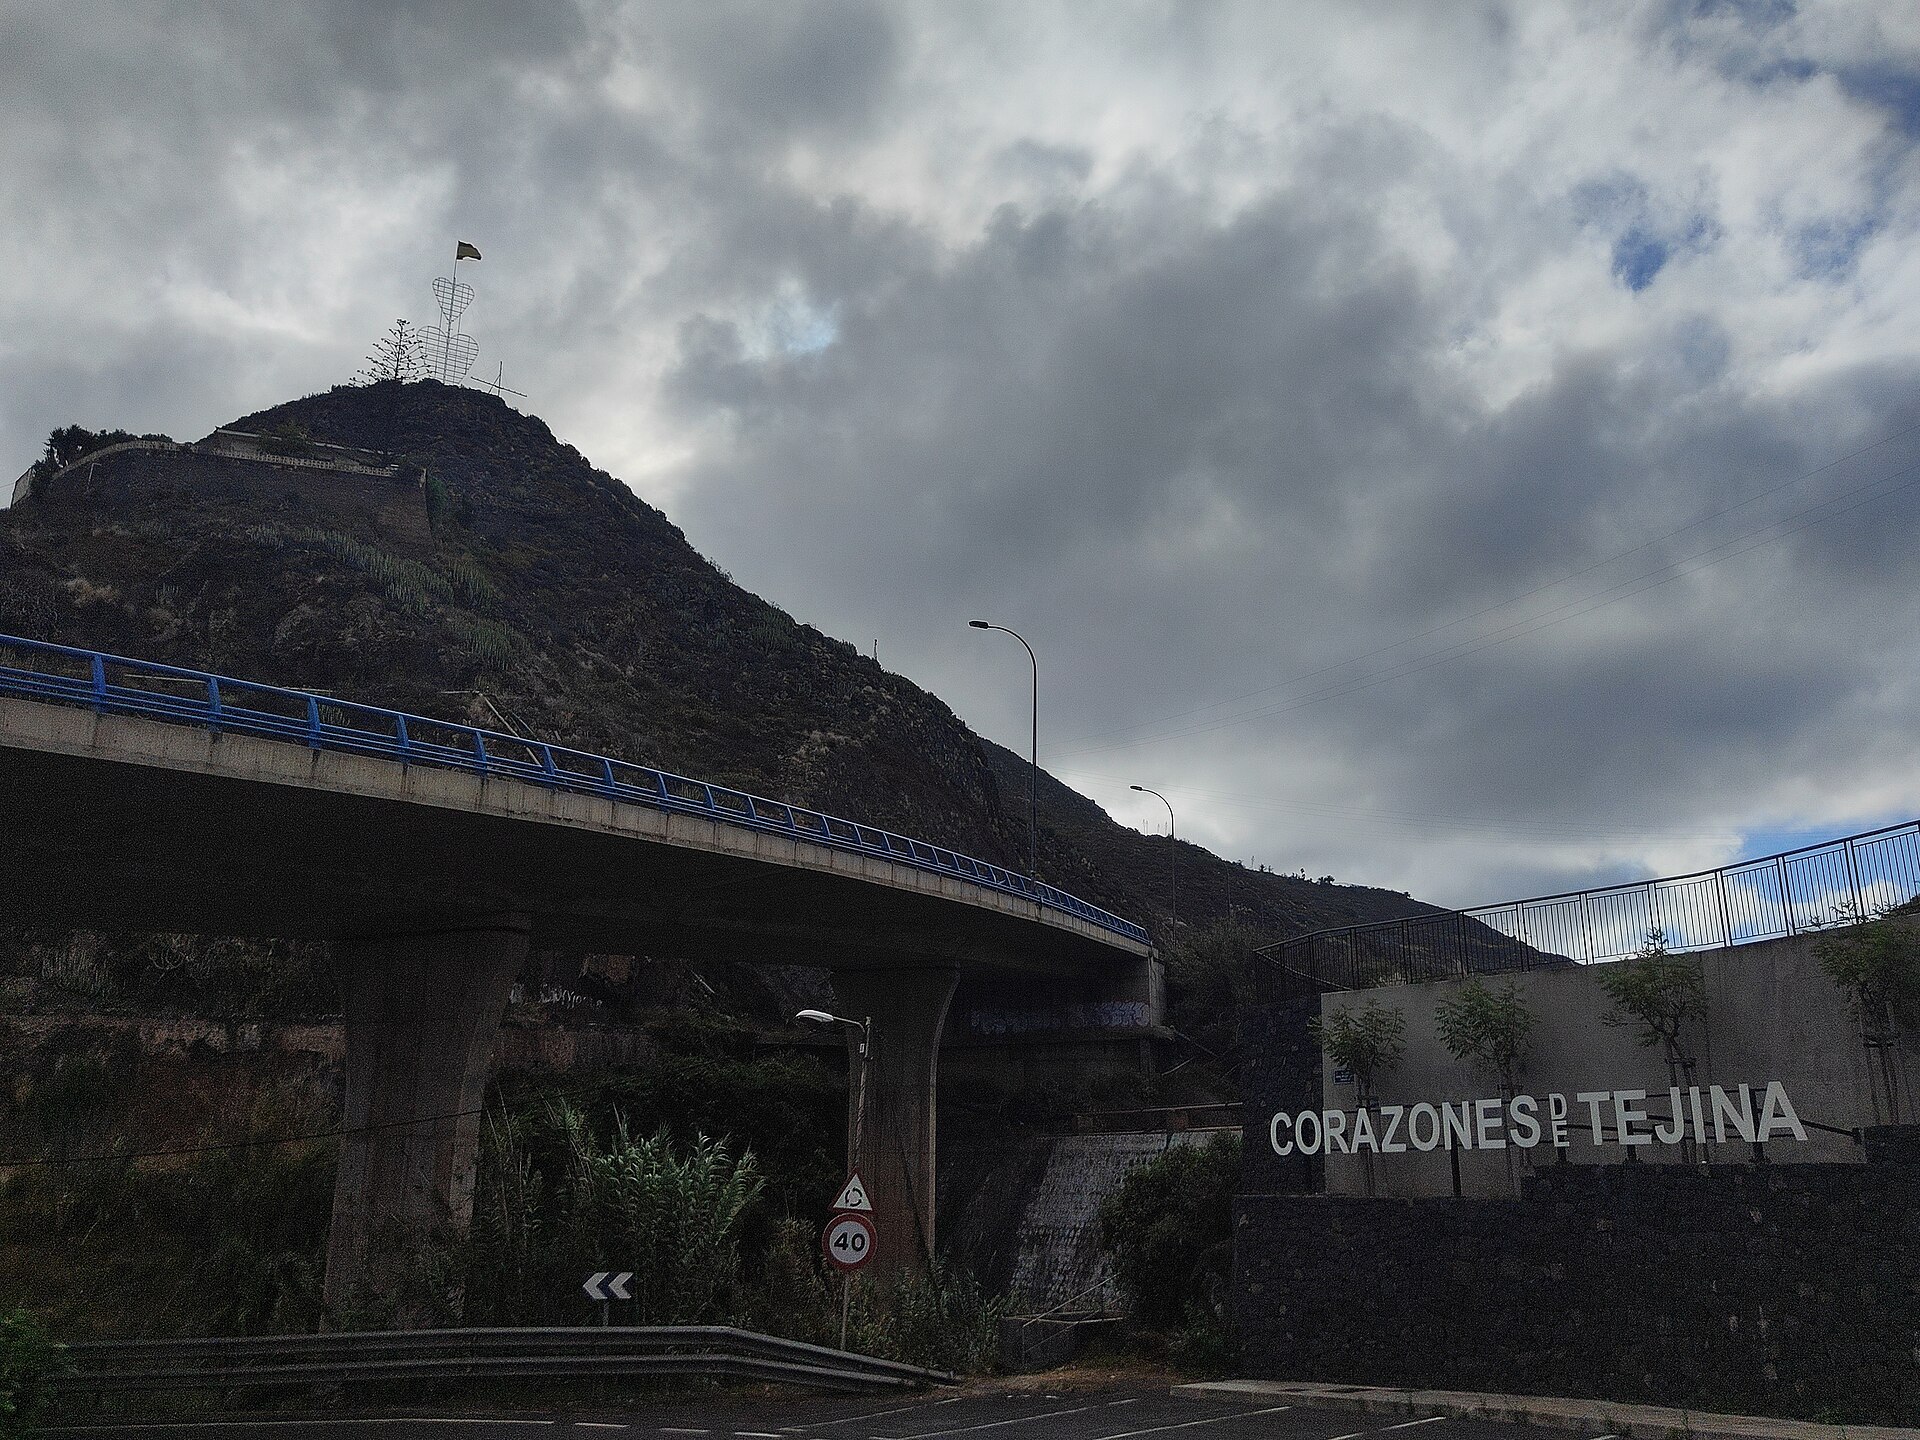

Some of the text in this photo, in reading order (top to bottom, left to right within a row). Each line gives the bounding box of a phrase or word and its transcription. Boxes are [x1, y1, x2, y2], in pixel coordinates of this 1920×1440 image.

[1270, 1080, 1808, 1155] CORAZONES DE TEJINA
[834, 1231, 866, 1252] 40
